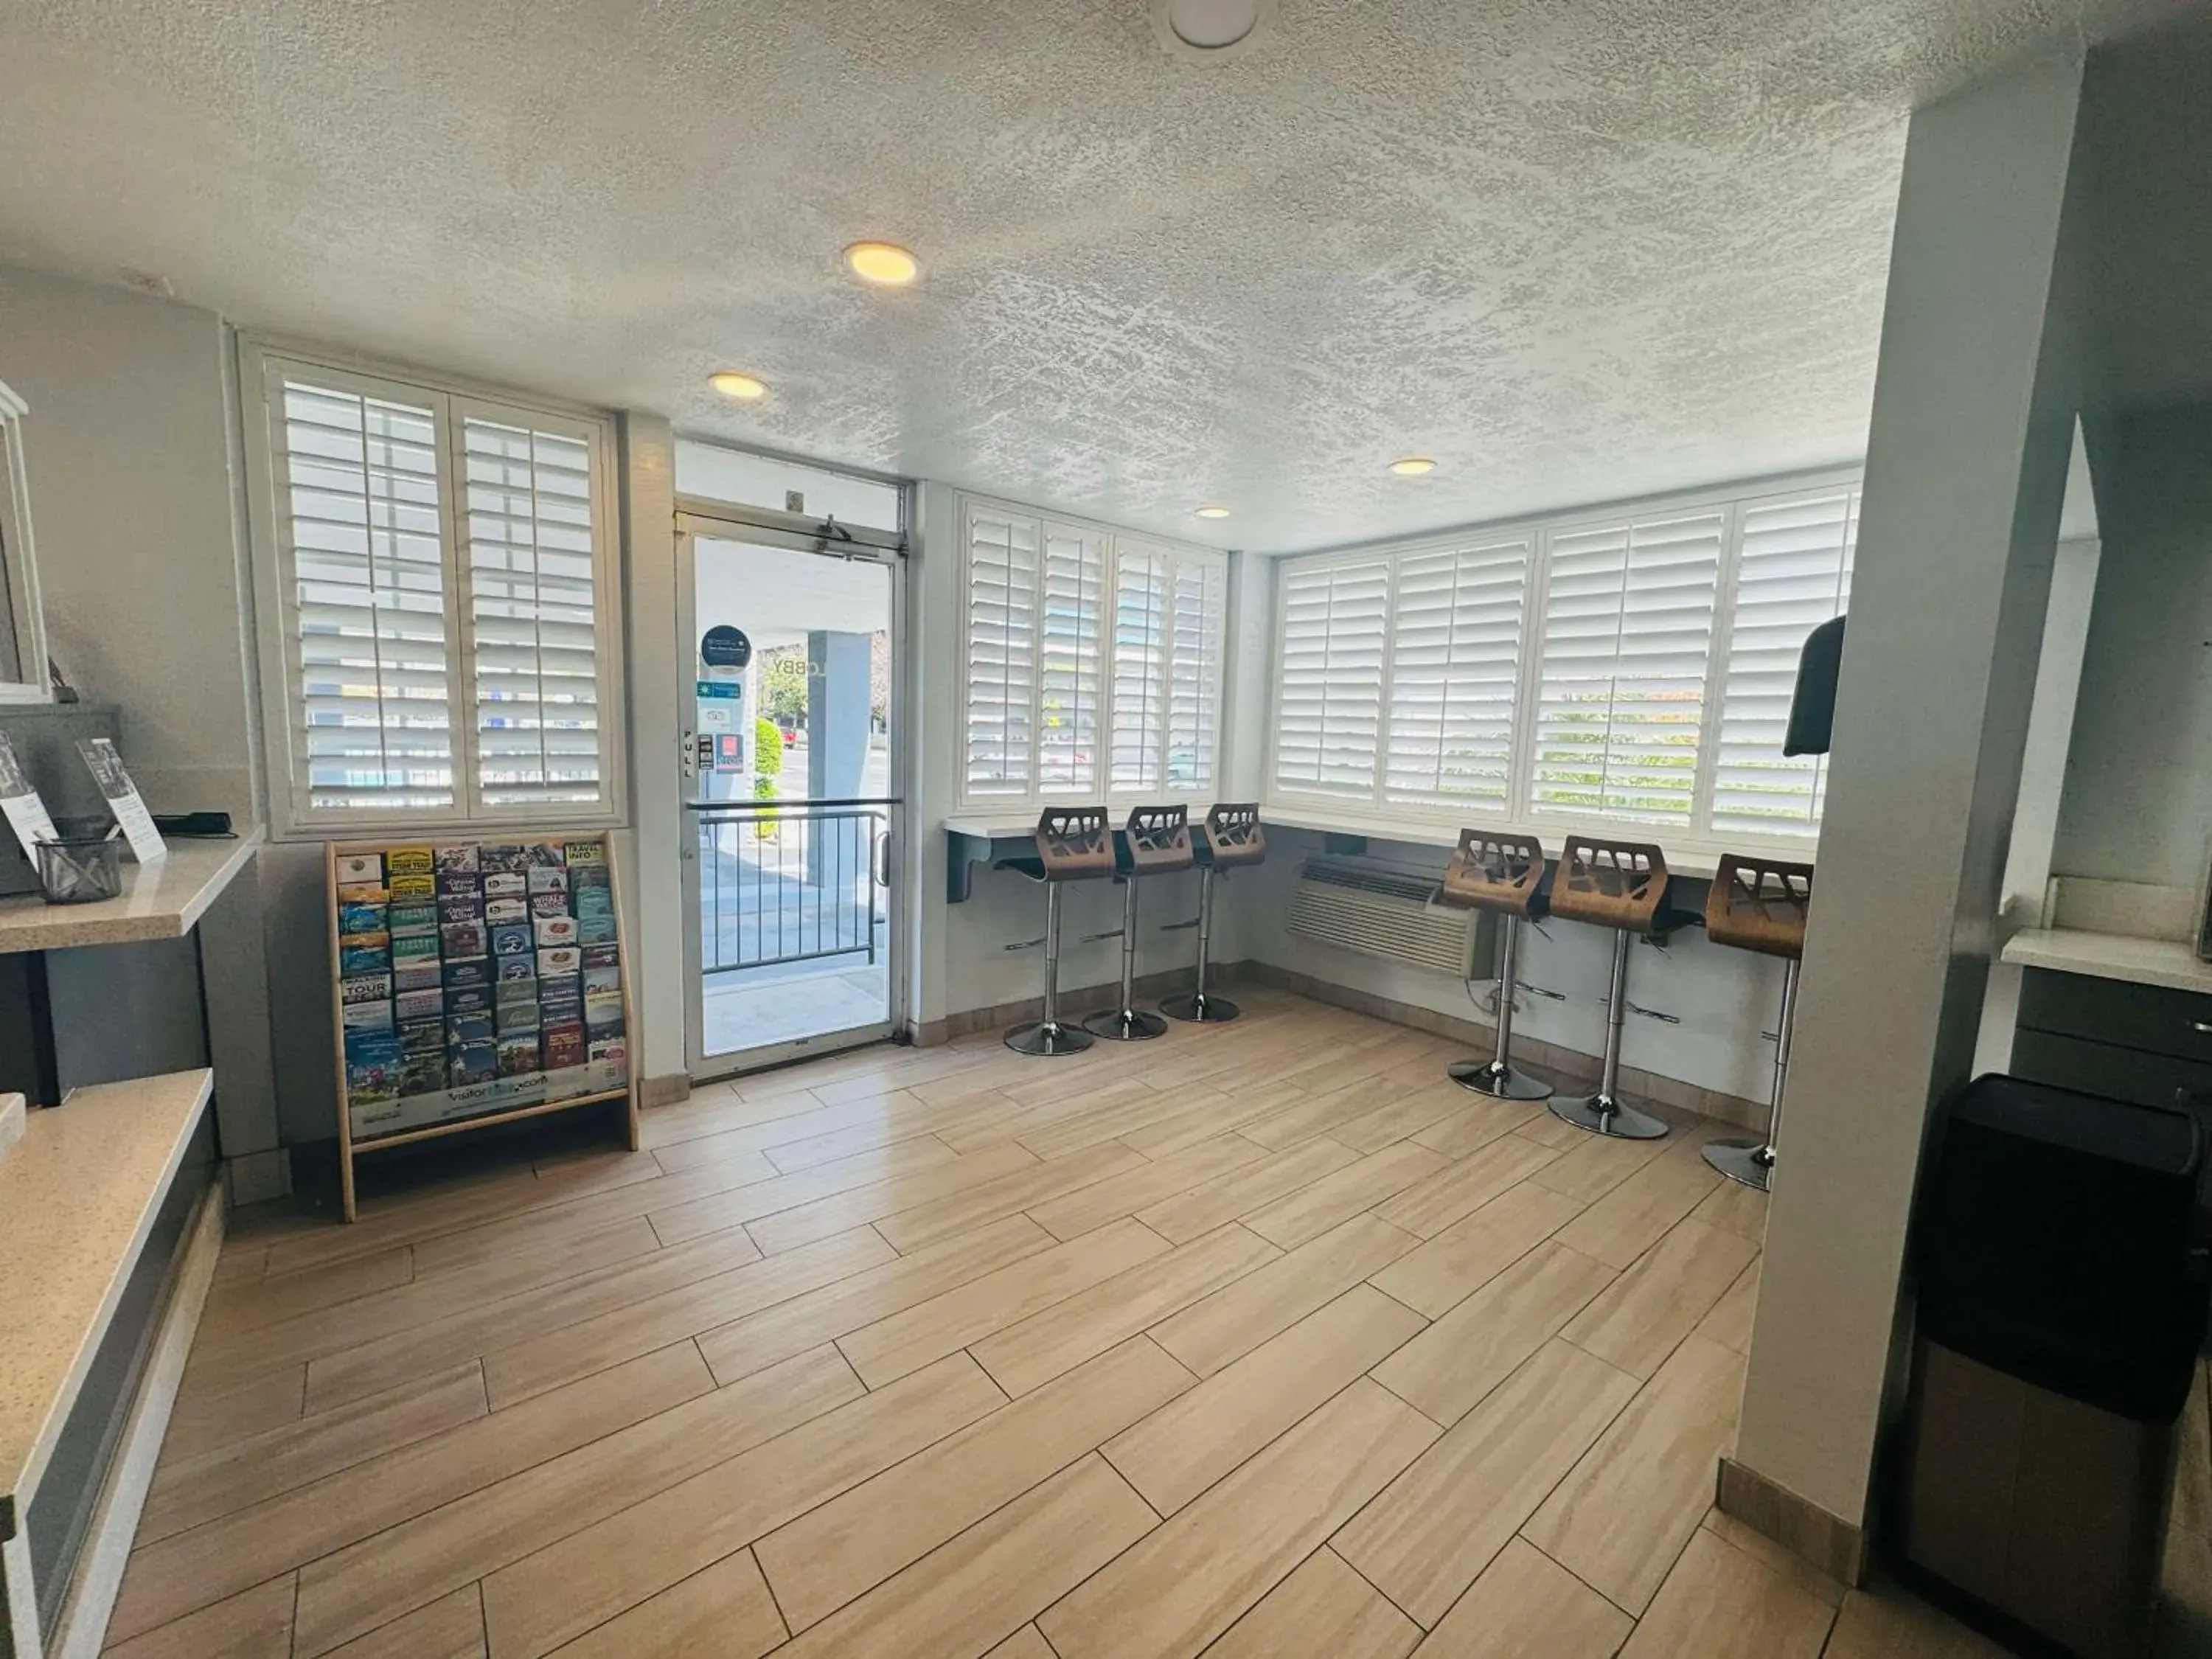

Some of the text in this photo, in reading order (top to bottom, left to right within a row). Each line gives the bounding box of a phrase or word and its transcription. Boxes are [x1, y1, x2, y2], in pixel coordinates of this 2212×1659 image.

[684, 730, 692, 778] PULL
[568, 851, 591, 859] INFO
[345, 983, 386, 995] TOUR
